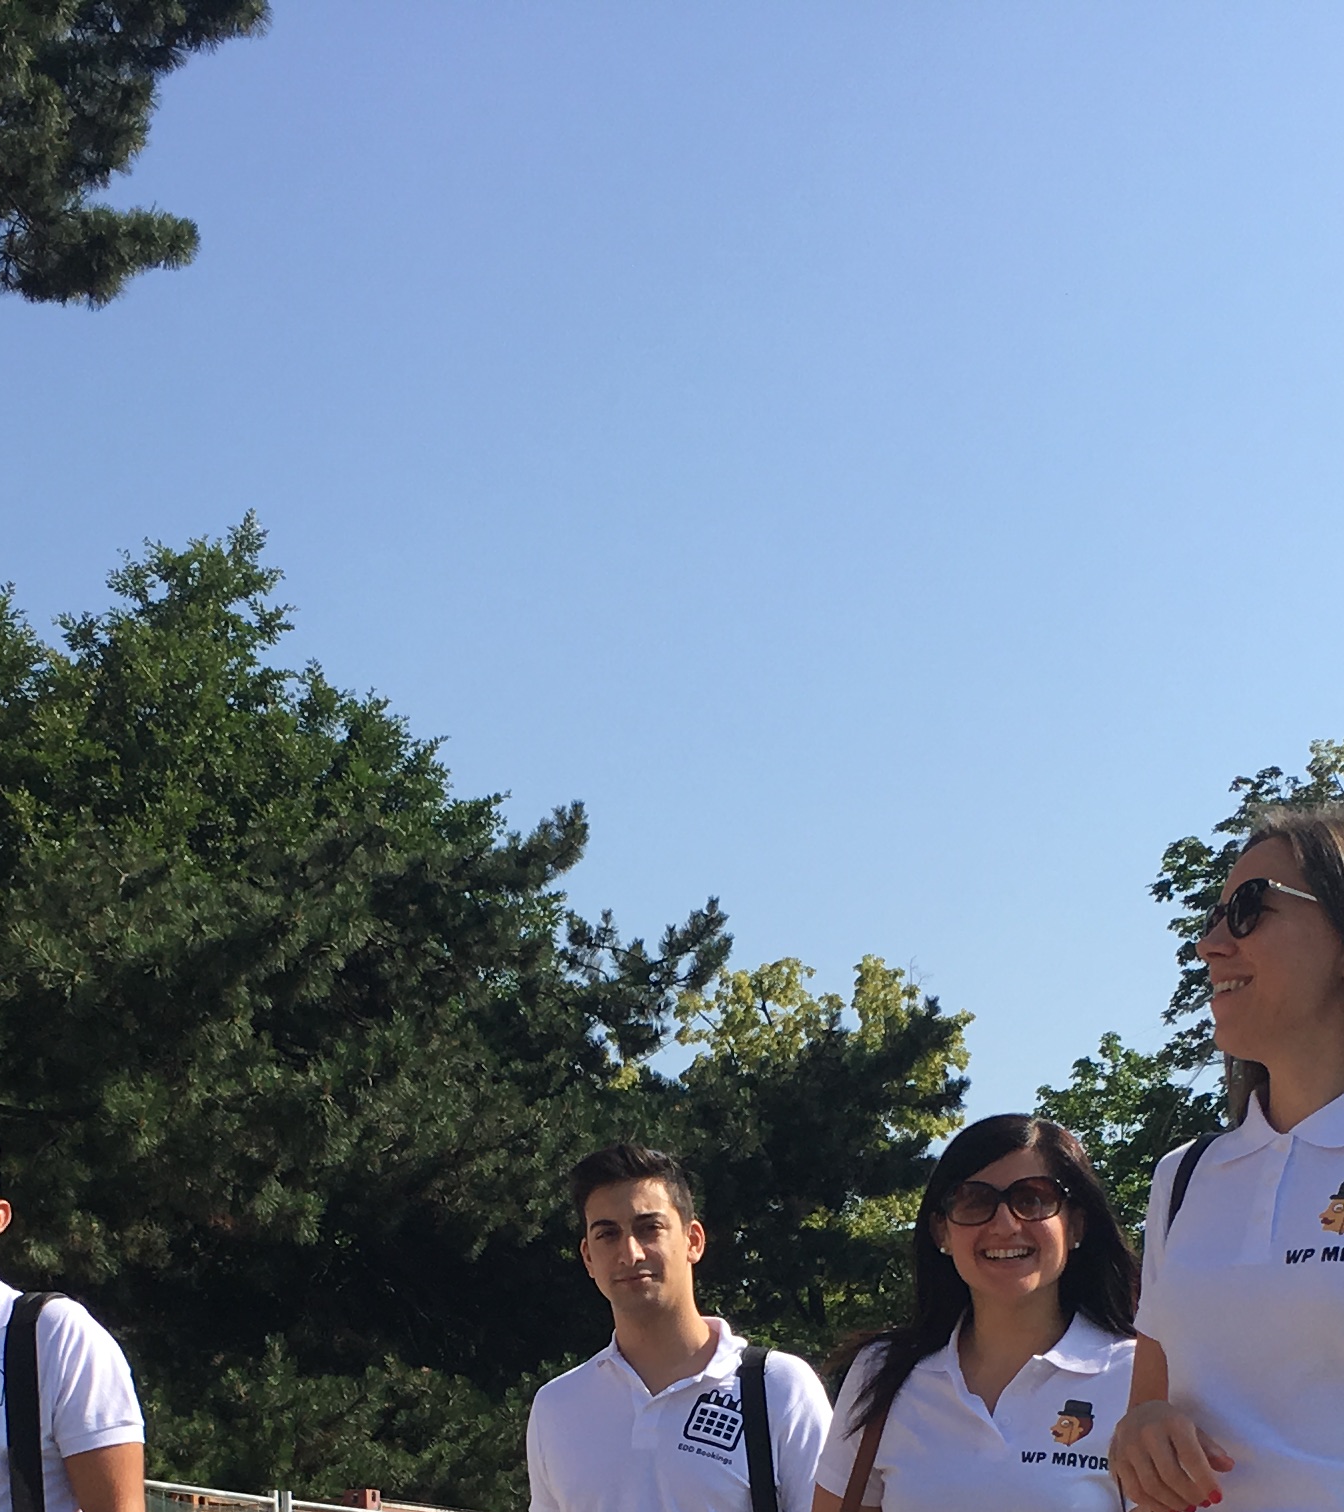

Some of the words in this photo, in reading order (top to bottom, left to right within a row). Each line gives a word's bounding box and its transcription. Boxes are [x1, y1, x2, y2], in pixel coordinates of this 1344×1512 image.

[1285, 1248, 1316, 1264] WP
[677, 1443, 696, 1453] EDD
[695, 1447, 733, 1465] Bookings
[1021, 1451, 1047, 1464] WP
[1051, 1452, 1110, 1471] MAYOR
